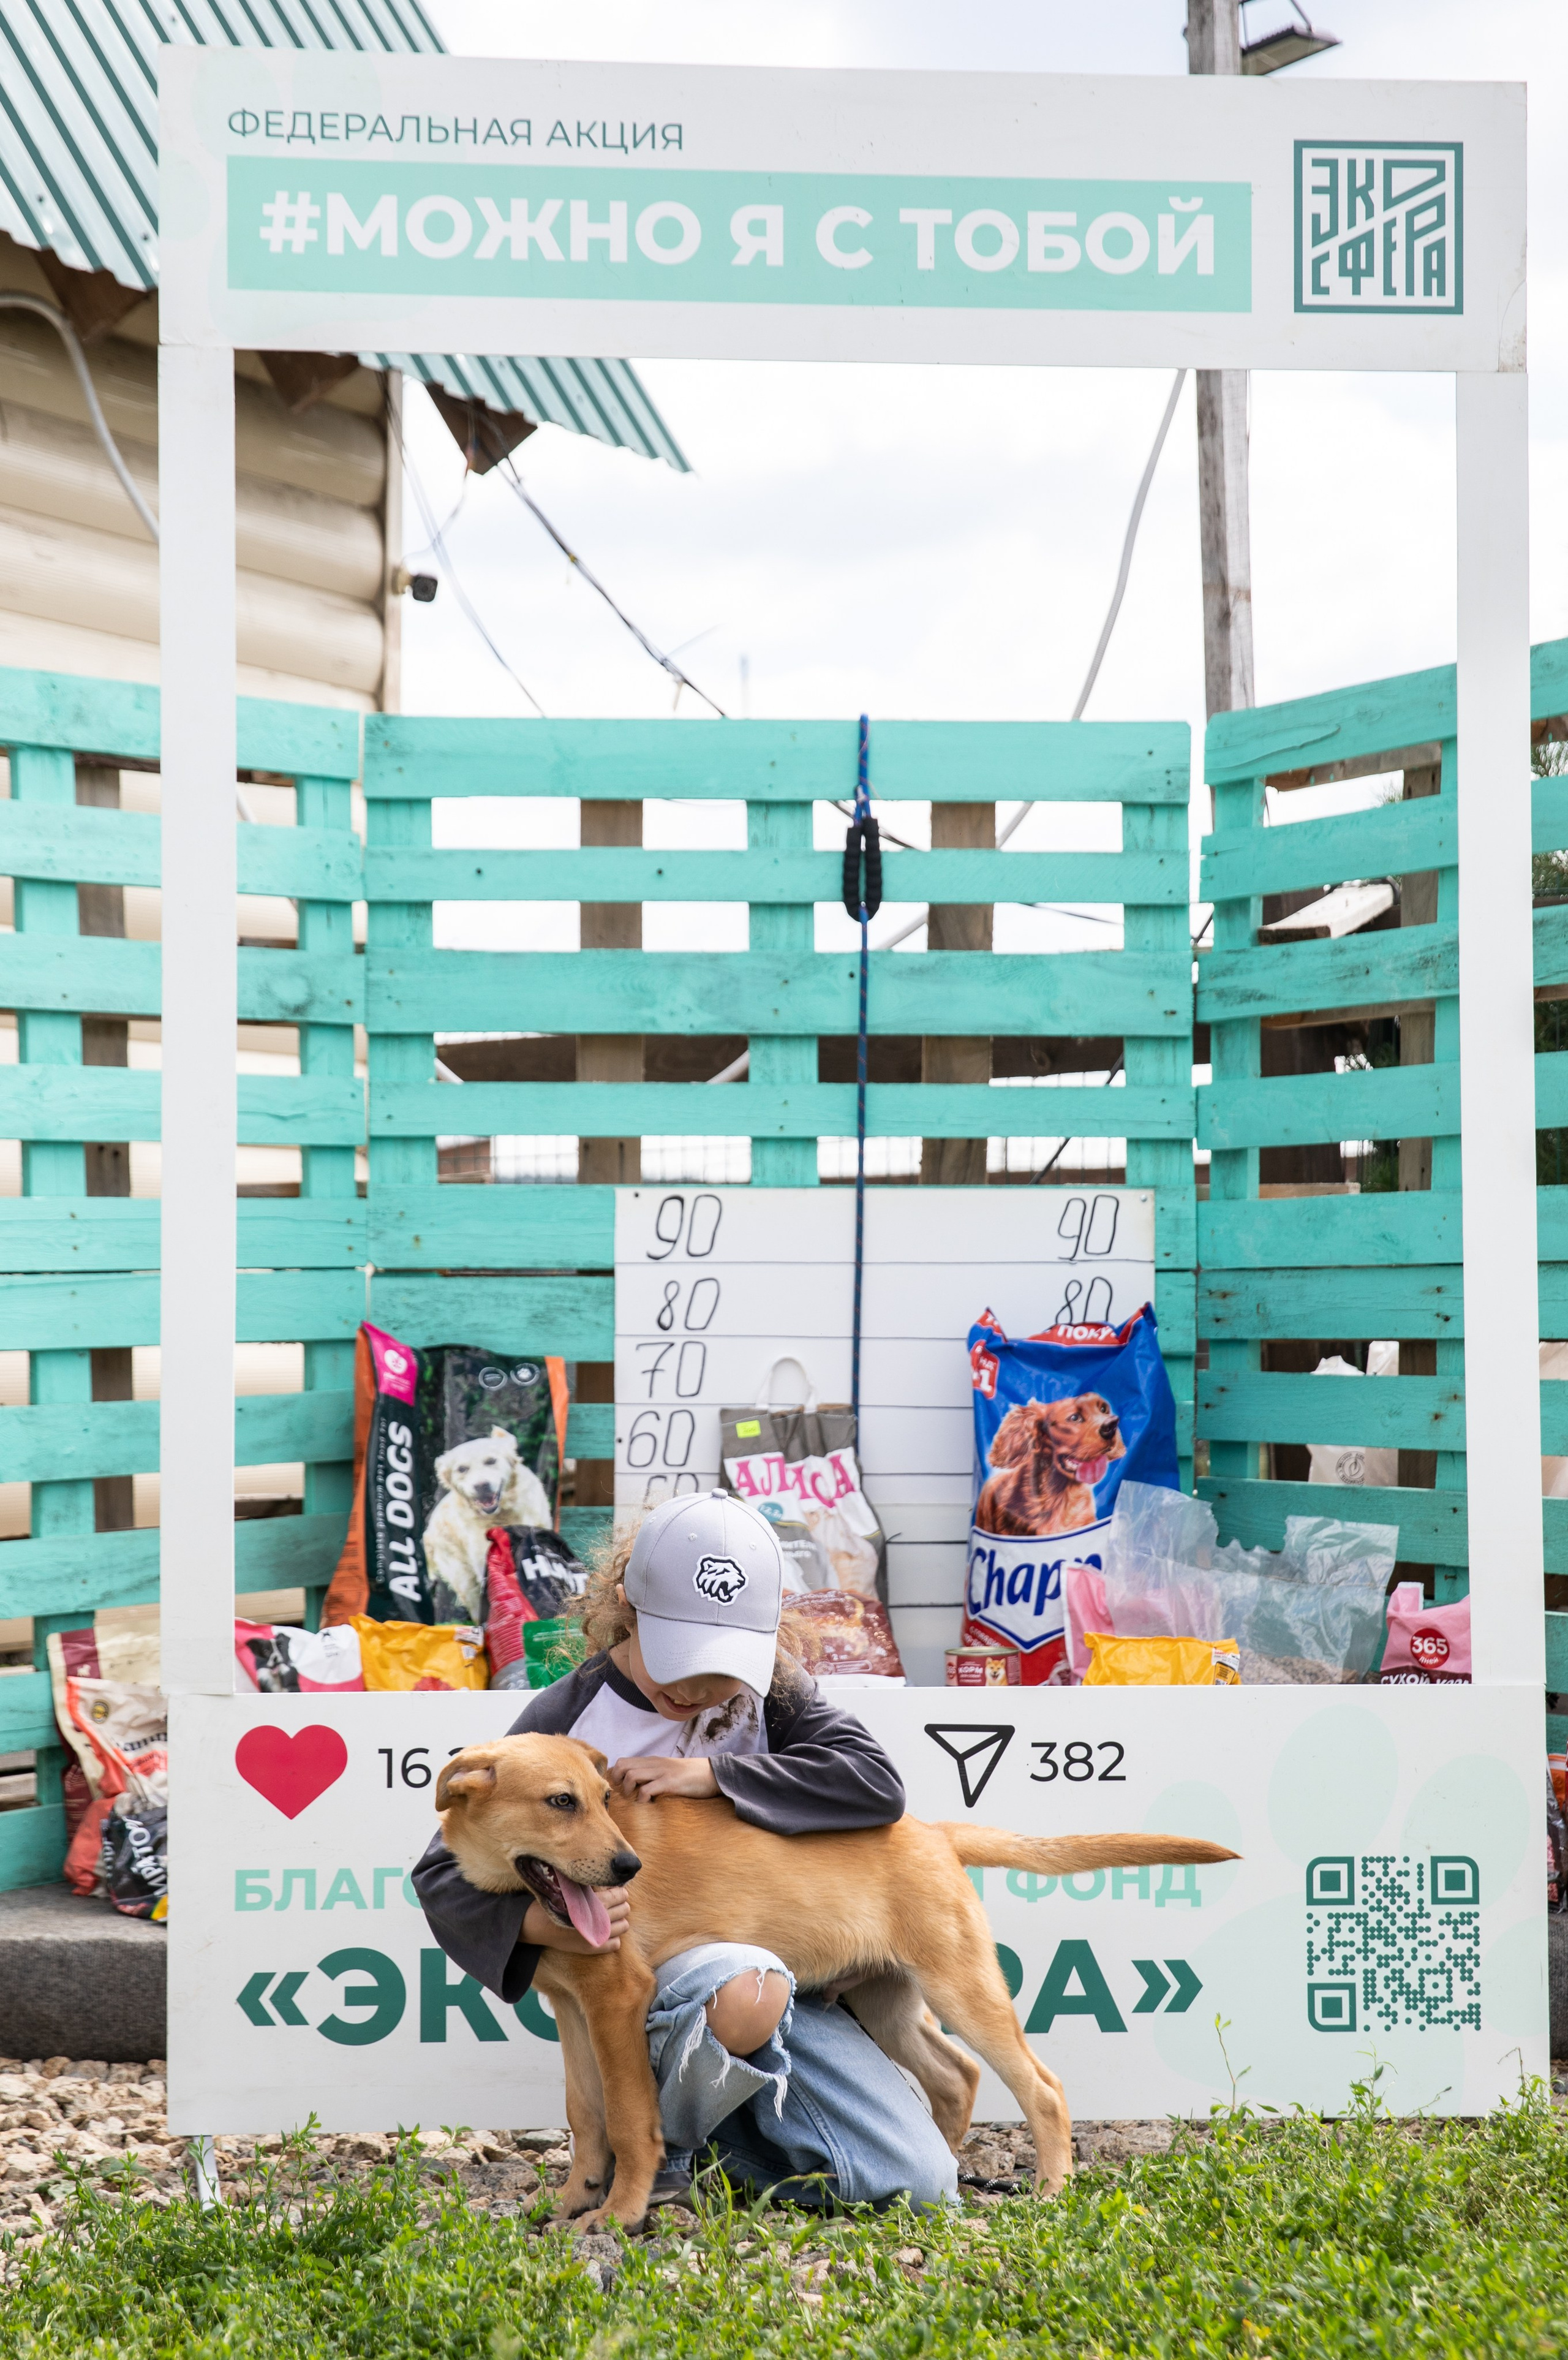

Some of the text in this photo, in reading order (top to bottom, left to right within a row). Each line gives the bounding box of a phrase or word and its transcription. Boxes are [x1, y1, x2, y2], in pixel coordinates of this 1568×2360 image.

[228, 108, 682, 154] ФЕДЕРАЛЬНАЯ АКЦИЯ
[259, 191, 1215, 276] #МОЖНО Я С ТОБОЙ
[646, 1194, 722, 1260] 90
[1057, 1195, 1120, 1262] 90
[656, 1278, 720, 1331] 80
[1057, 1324, 1117, 1341] ПОКУ
[635, 1341, 706, 1398] 70
[627, 1410, 696, 1467] 60
[385, 1421, 415, 1529] DOGS
[388, 1537, 423, 1603] ALL
[968, 1546, 1102, 1616] Chap
[1411, 1635, 1449, 1655] 365
[378, 1747, 432, 1788] 16
[1030, 1741, 1126, 1782] 382
